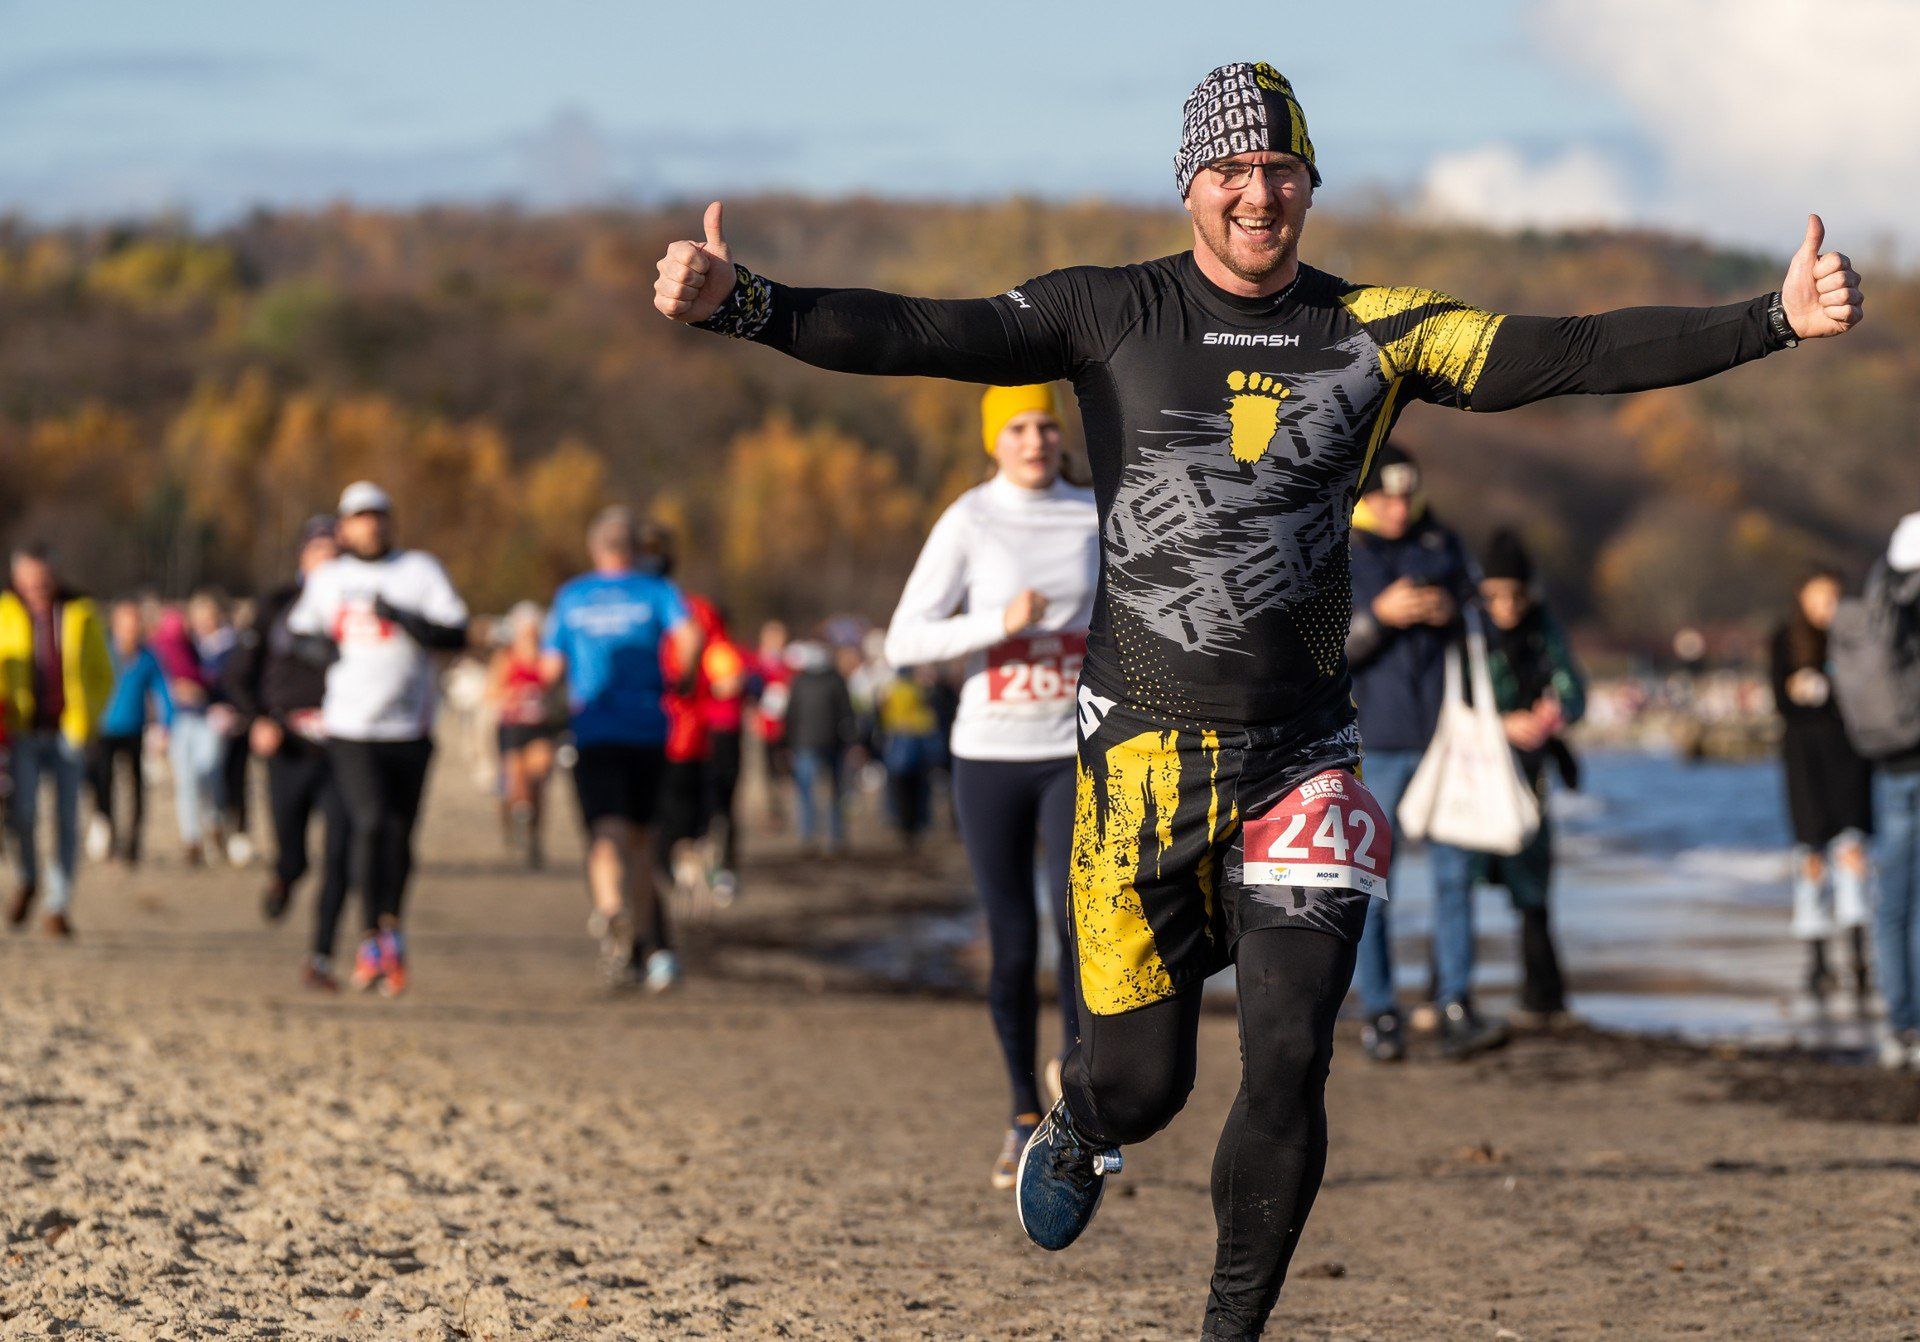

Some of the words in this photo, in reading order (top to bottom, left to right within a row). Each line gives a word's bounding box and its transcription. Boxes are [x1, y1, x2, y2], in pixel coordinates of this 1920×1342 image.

[1202, 332, 1300, 347] SMMASH
[1299, 778, 1344, 800] BIEG
[1267, 804, 1376, 870] 242
